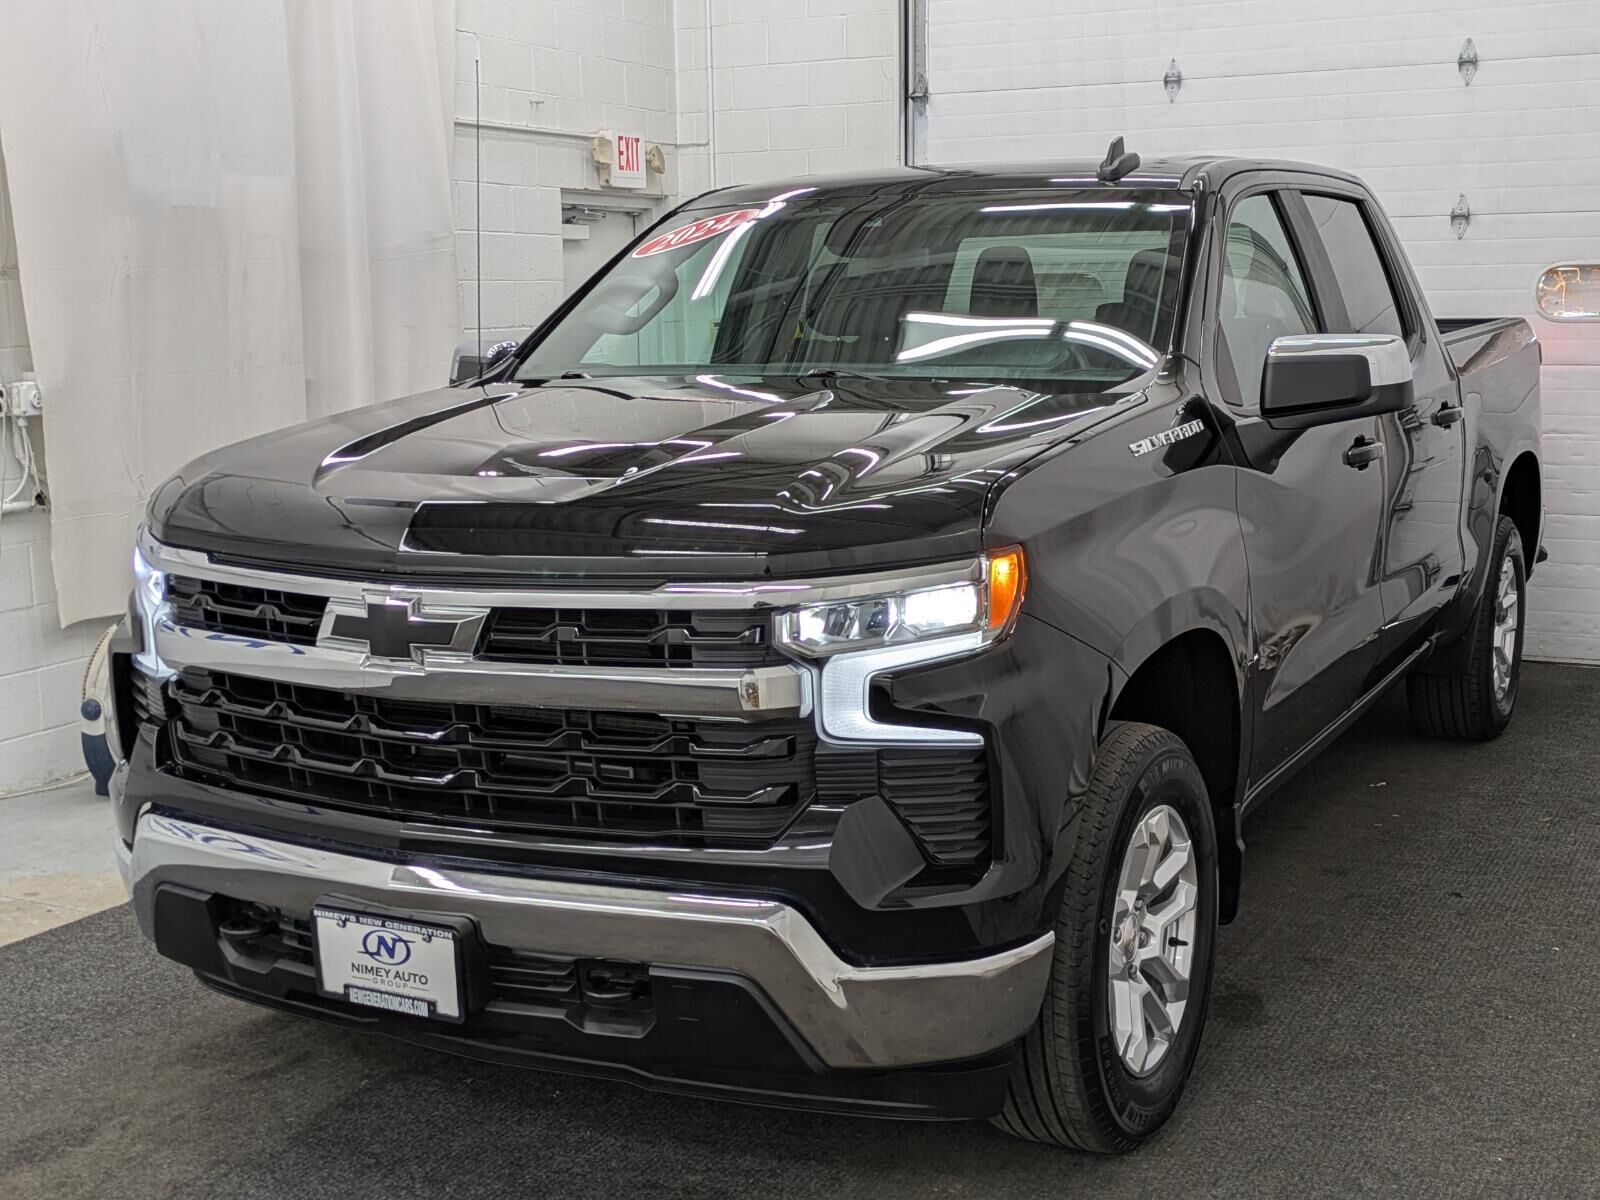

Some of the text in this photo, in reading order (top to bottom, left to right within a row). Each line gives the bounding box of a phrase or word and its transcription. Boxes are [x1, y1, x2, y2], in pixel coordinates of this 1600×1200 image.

[617, 135, 640, 172] EXIT
[650, 212, 737, 251] 2024
[1128, 418, 1205, 457] SILVERADO
[313, 909, 453, 939] NIMEY'S NEW GENERATION
[351, 962, 428, 985] NIMEY AUTO
[372, 977, 408, 989] GROUP
[349, 987, 429, 1018] NEWGENERATIONCARS.COM
